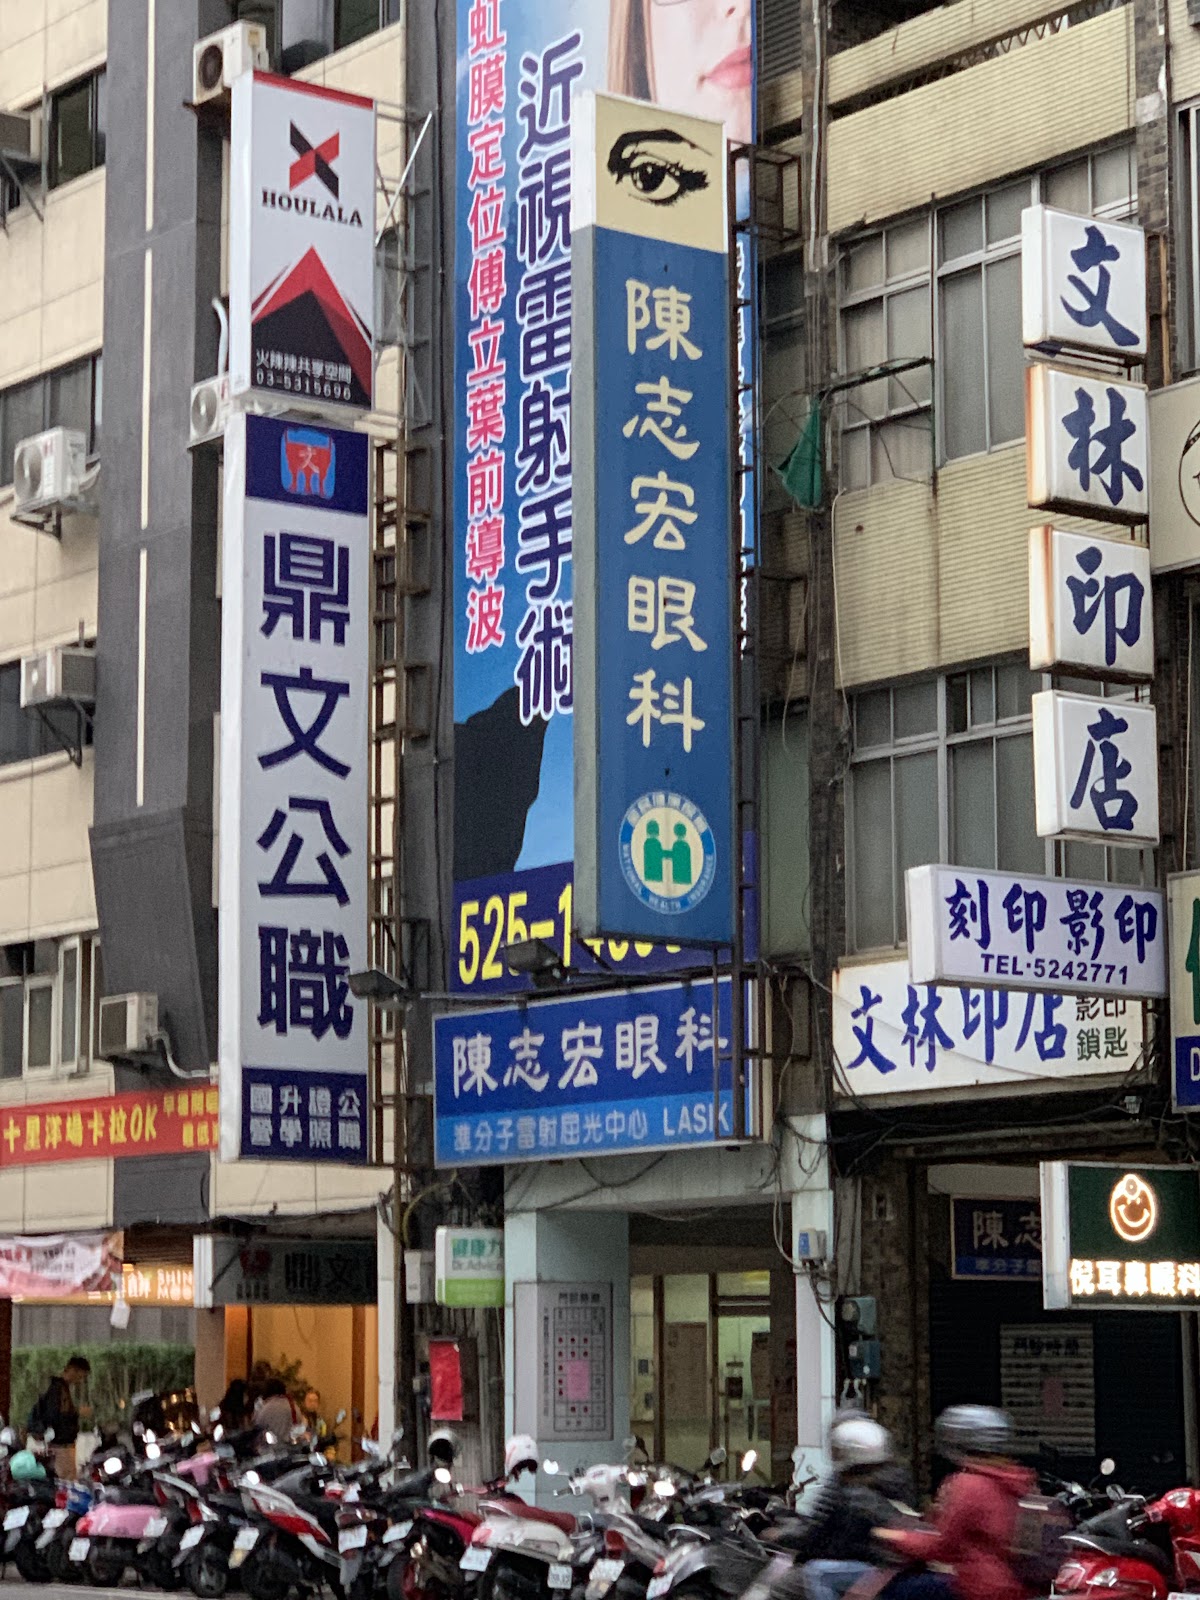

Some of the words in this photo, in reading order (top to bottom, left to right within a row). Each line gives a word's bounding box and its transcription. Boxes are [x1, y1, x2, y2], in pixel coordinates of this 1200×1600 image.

[261, 187, 363, 228] HOULALA
[467, 0, 506, 651] 虹膜定位傅立葉前導波
[515, 33, 584, 725] 近視雷射手術
[622, 279, 707, 752] 陳志宏眼科
[259, 532, 355, 1041] 鼎文公職
[944, 878, 1158, 964] 刻印影印
[451, 1006, 729, 1099] 陳志宏眼科
[846, 984, 1069, 1075] 文林印店
[1075, 994, 1128, 1022] 影印
[1075, 1026, 1129, 1061] 鎖匙
[662, 1101, 730, 1137] LASIK
